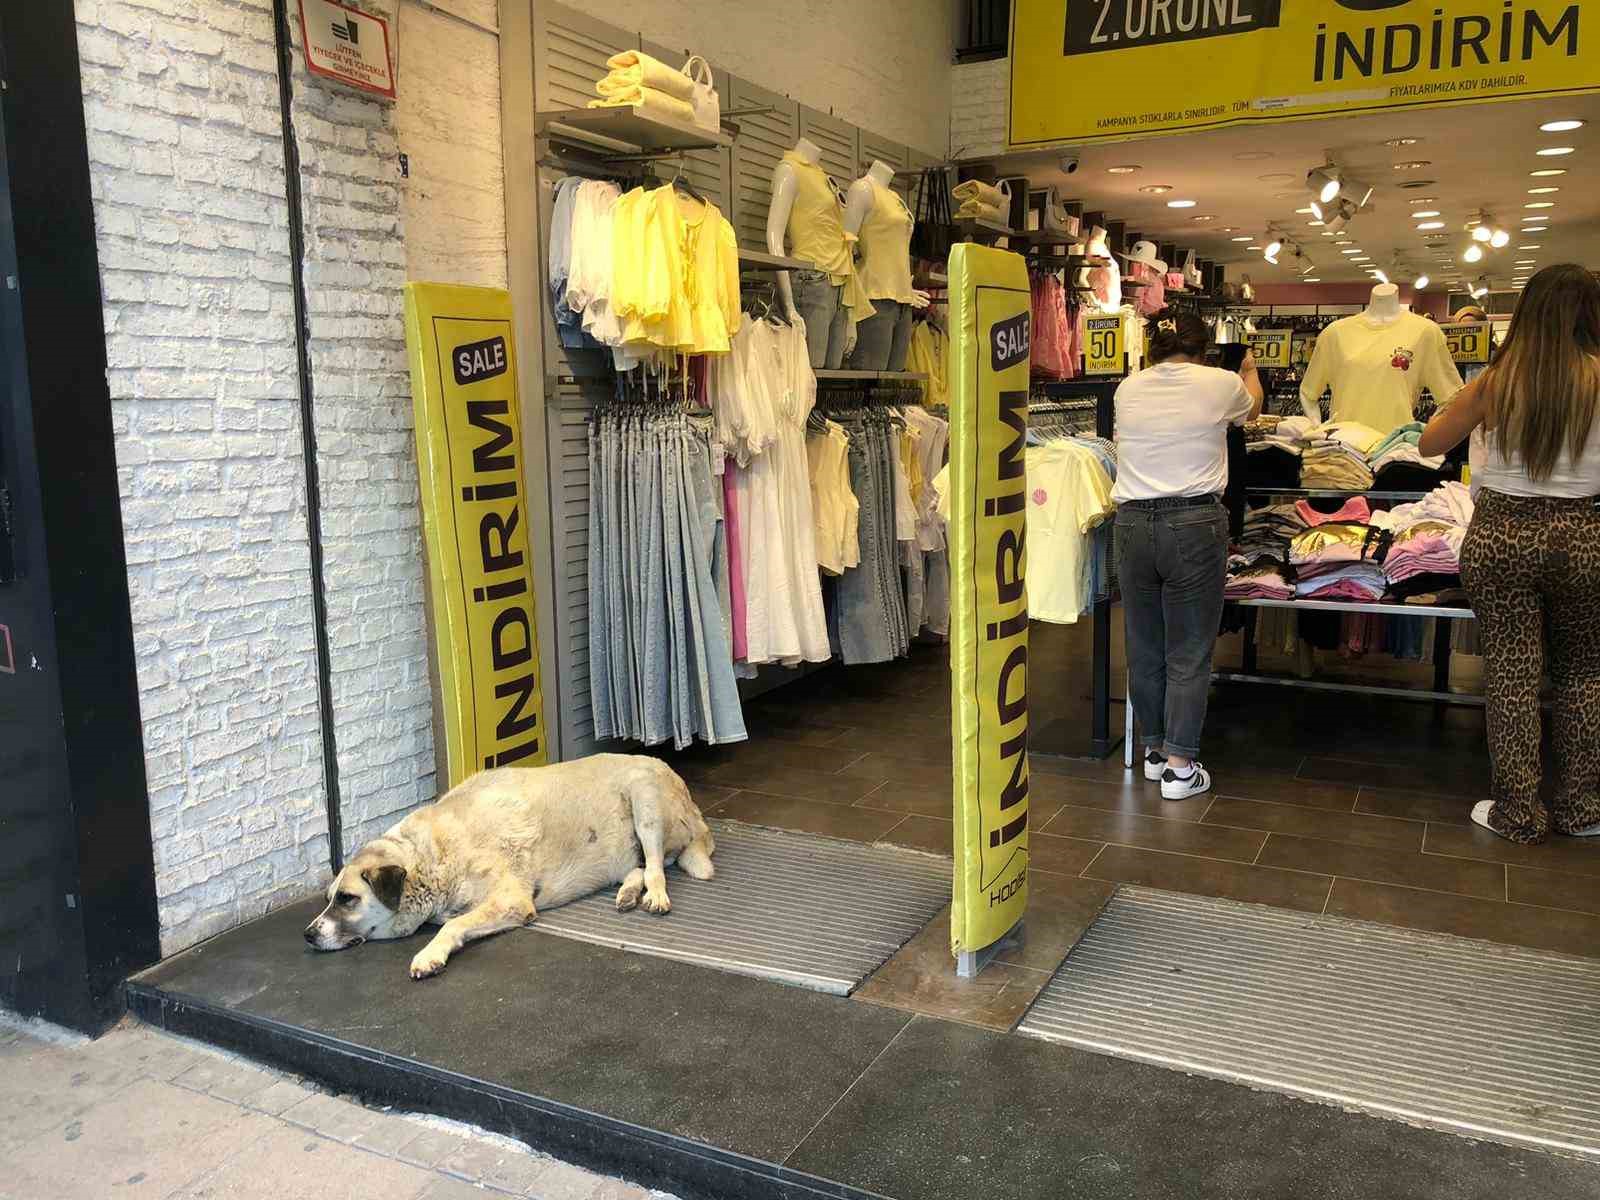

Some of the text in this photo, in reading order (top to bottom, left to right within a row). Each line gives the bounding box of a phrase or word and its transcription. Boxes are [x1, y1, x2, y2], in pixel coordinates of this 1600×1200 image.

[1313, 0, 1580, 82] İNDİRİM
[1096, 116, 1137, 128] KAMPANYA
[1139, 111, 1183, 124] STOKLARLA
[1458, 79, 1479, 91] KDV
[459, 343, 504, 377] SALE
[997, 320, 1028, 361] SALE
[1090, 331, 1116, 359] 50
[1250, 341, 1280, 358] 50
[1445, 335, 1477, 354] 50
[463, 400, 538, 770] İNDİRİM
[985, 391, 1029, 848] İNDİRİM
